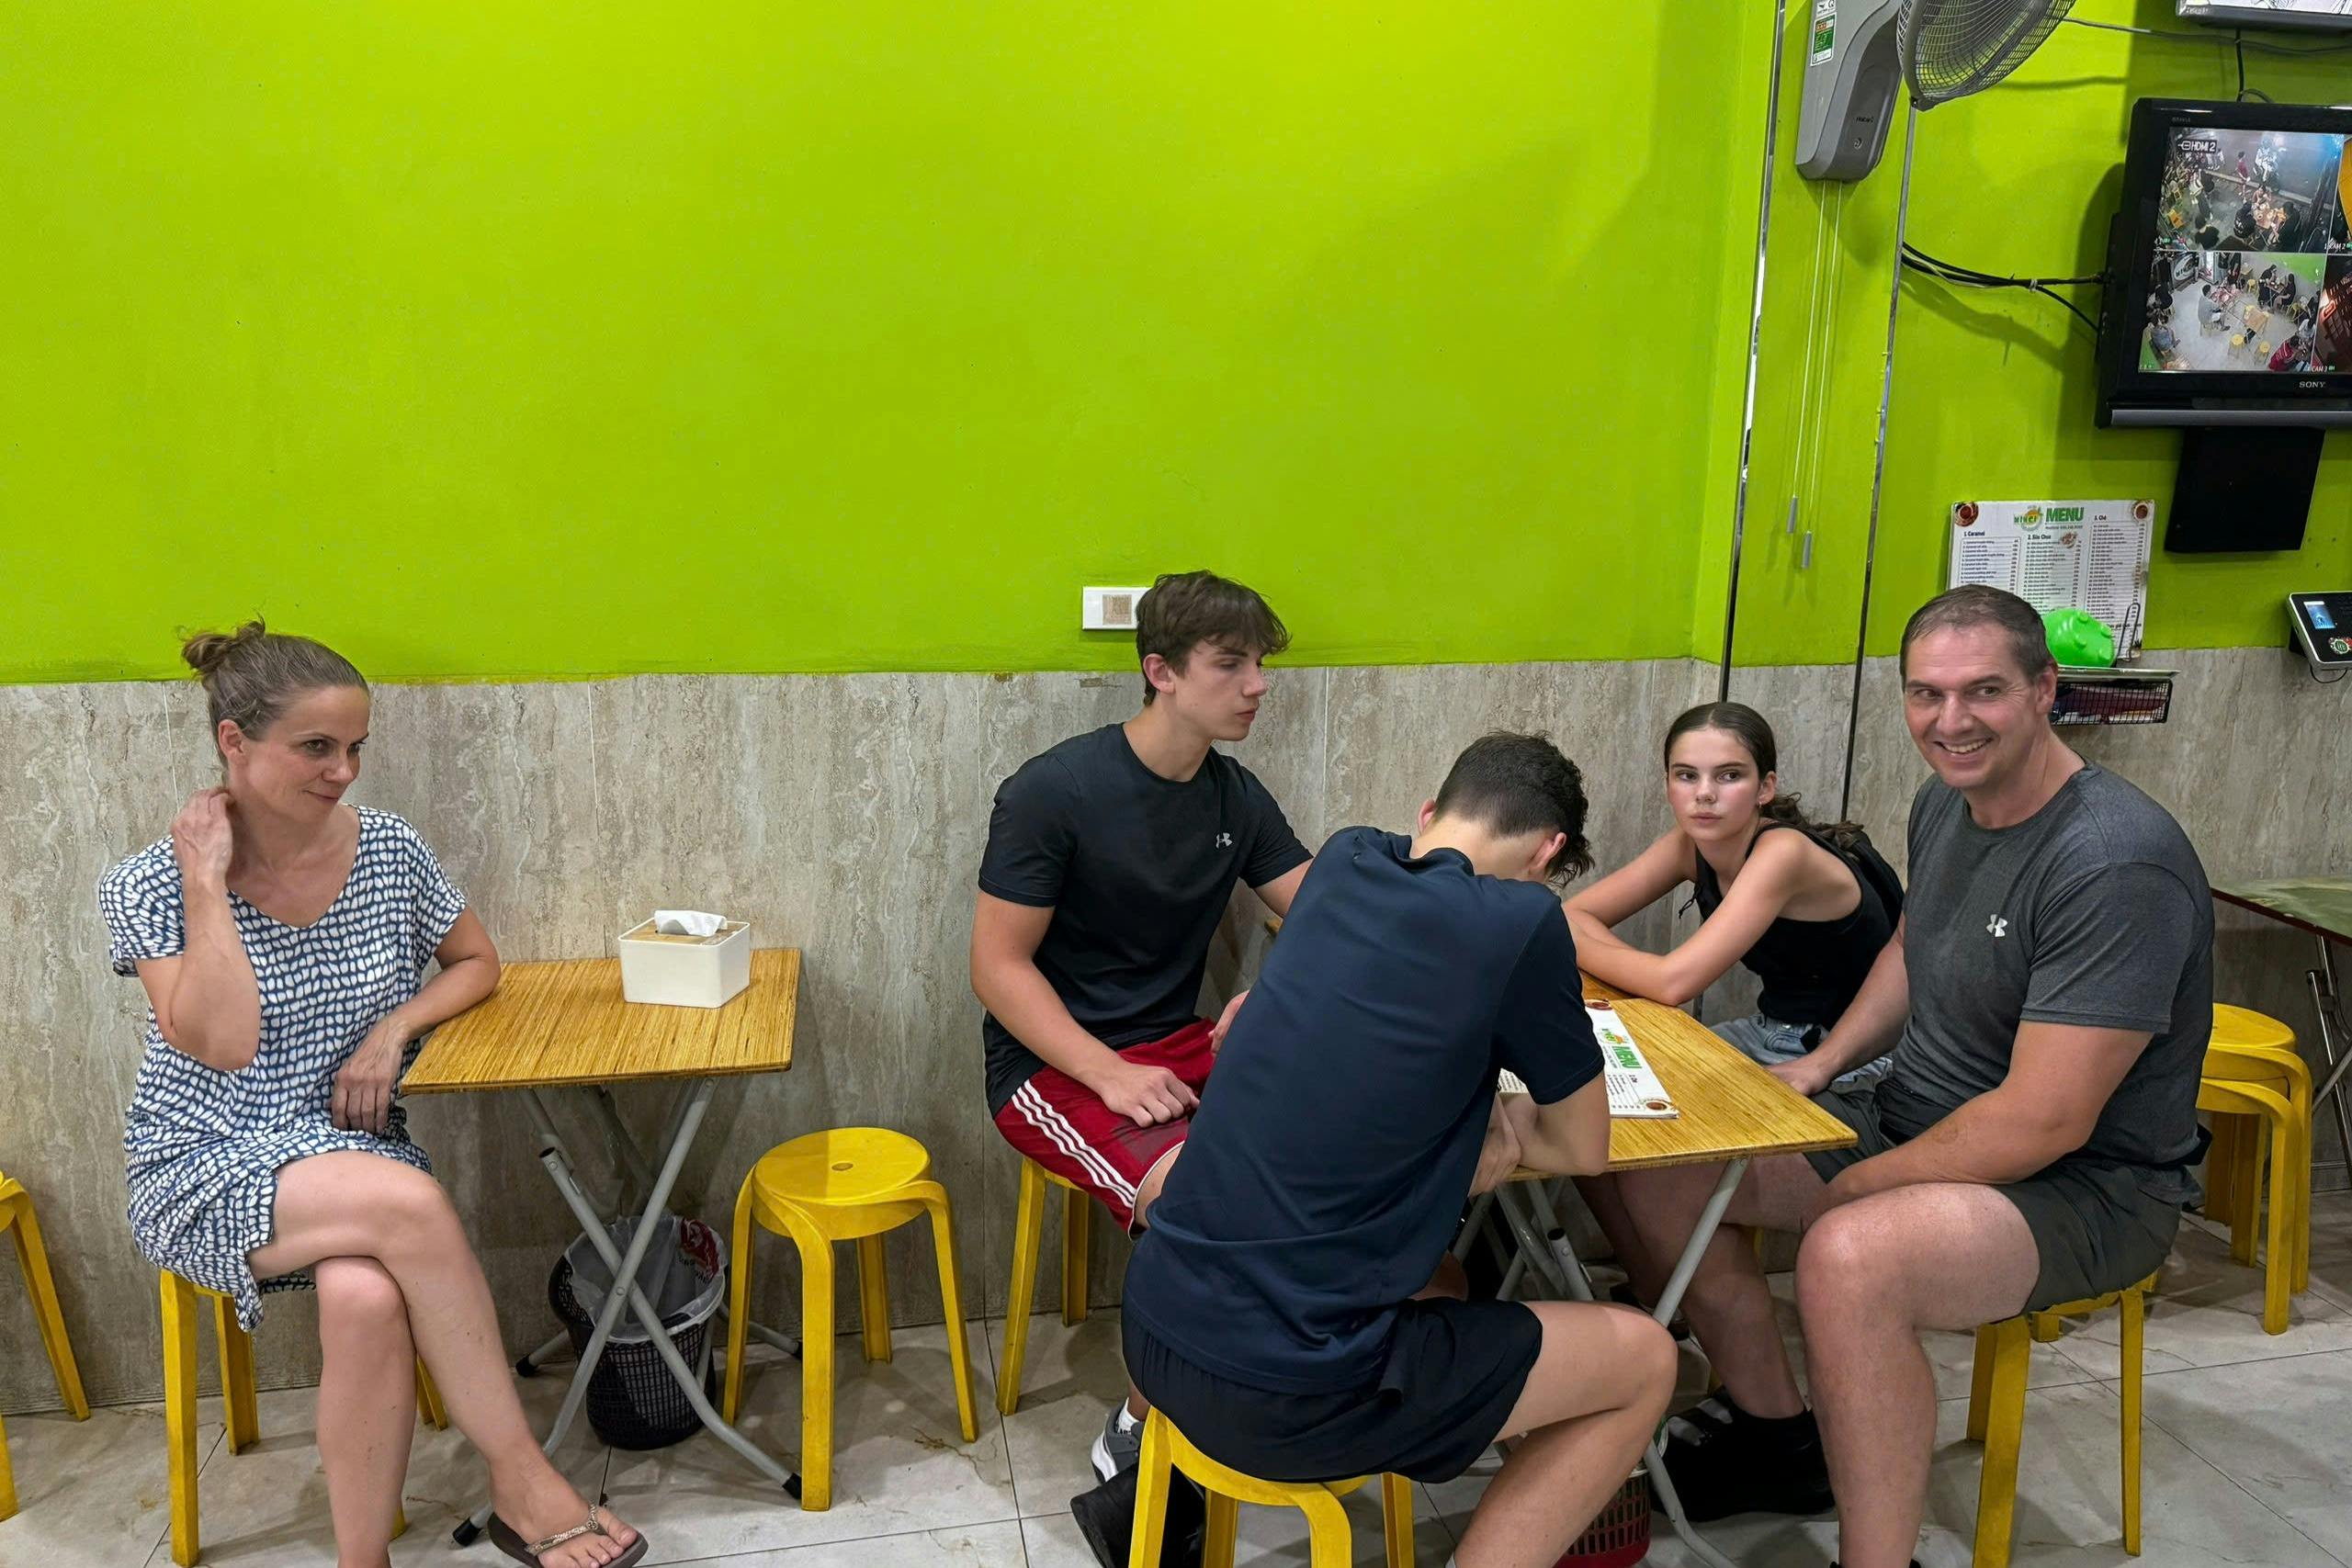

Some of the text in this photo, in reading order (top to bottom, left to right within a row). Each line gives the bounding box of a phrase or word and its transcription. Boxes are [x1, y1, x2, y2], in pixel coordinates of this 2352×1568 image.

[2190, 141, 2216, 152] HDMI 2
[2045, 507, 2085, 523] MENU
[1611, 1045, 1643, 1068] MENU
